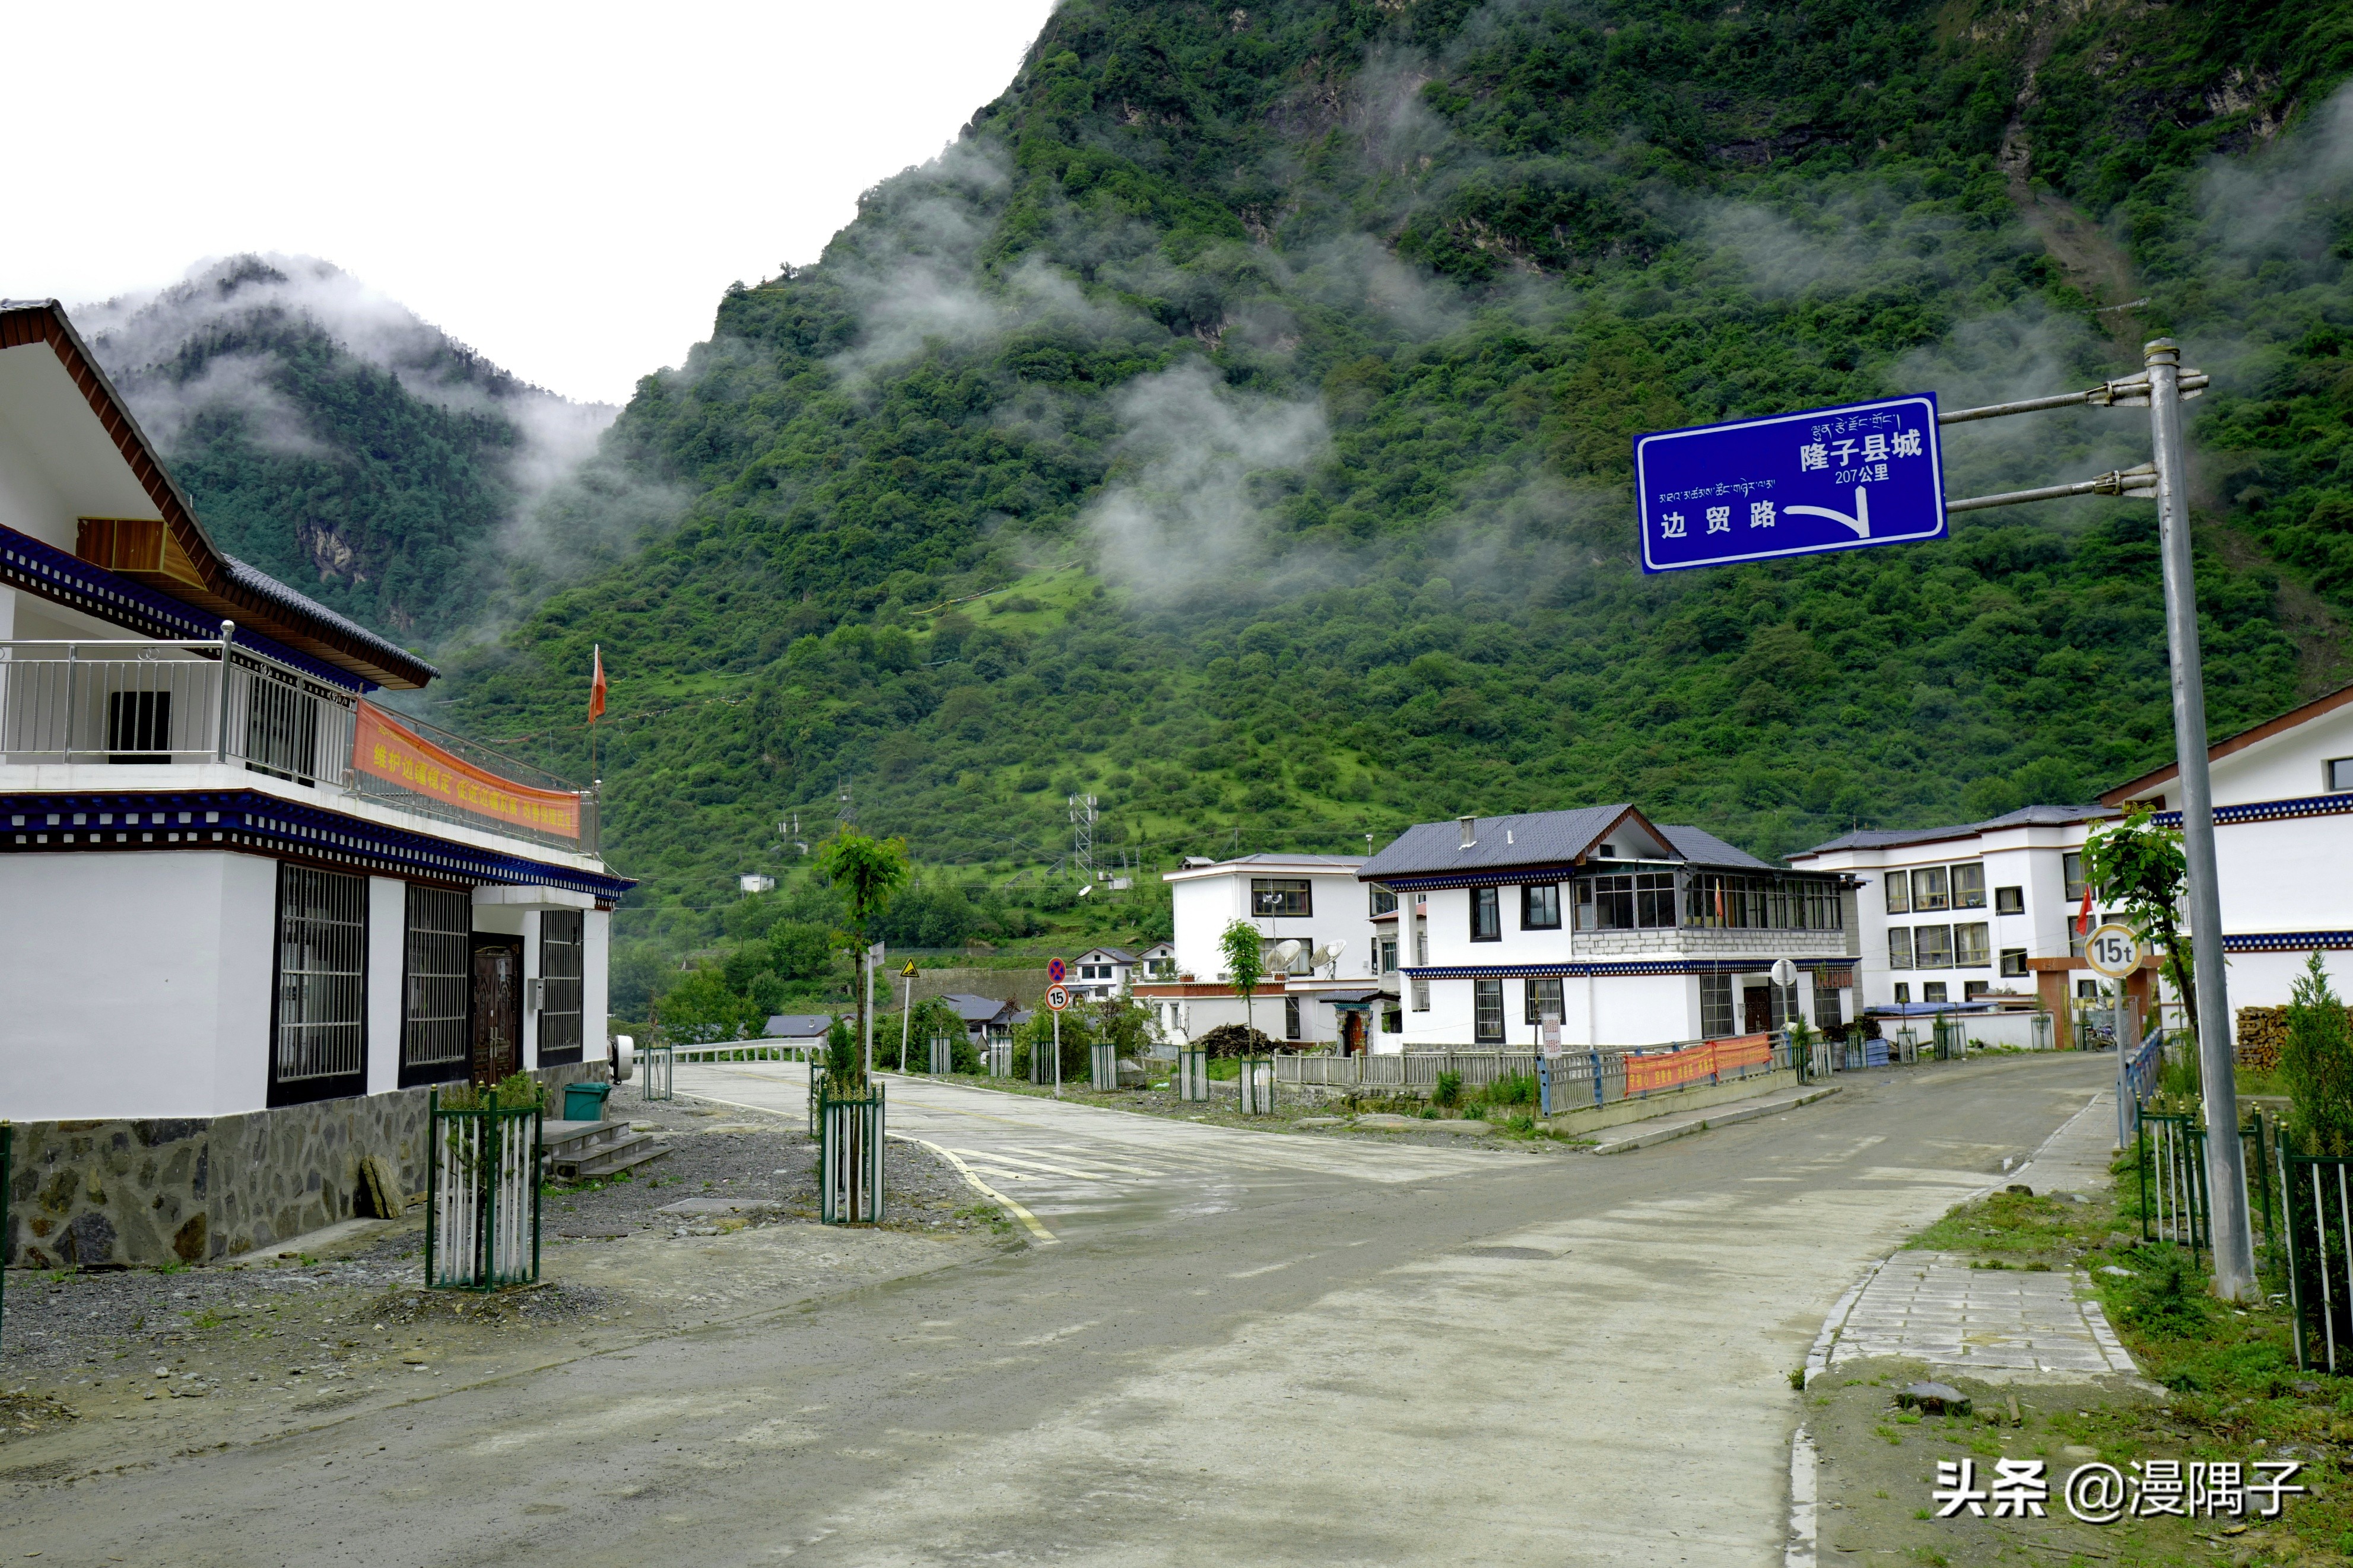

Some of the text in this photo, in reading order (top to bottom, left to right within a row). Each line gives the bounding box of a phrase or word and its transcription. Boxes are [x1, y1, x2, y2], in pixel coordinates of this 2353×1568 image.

[1801, 429, 1922, 472] 隆子县城
[1836, 463, 1890, 484] 207公里
[1661, 500, 1776, 539] 边贸路
[374, 743, 453, 794] 维护边疆稳定
[456, 779, 519, 816] 促进边疆发展
[2094, 938, 2132, 963] 15t
[1050, 992, 1063, 1004] 15
[1630, 1072, 1649, 1087] 守初心
